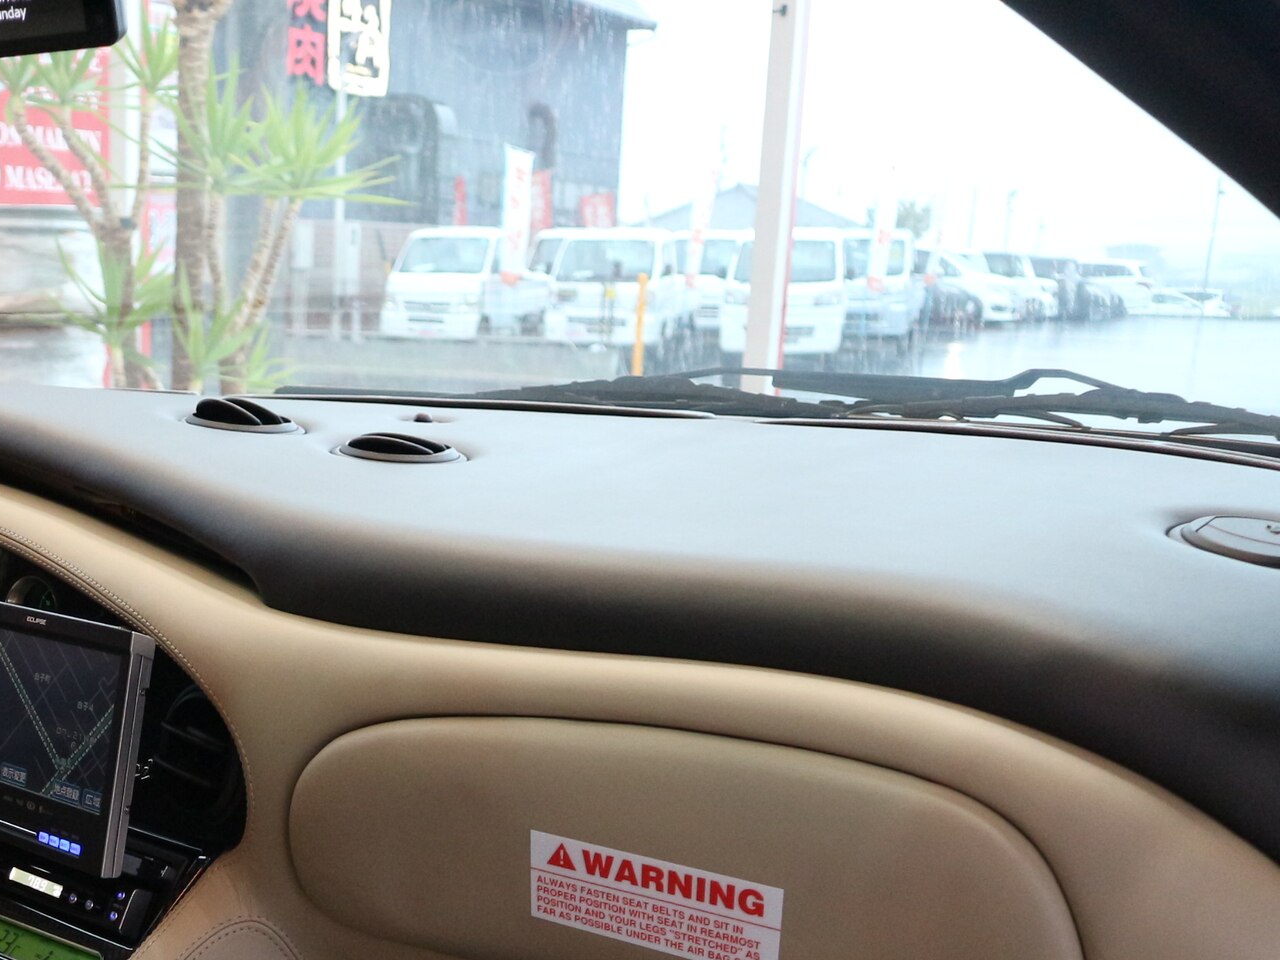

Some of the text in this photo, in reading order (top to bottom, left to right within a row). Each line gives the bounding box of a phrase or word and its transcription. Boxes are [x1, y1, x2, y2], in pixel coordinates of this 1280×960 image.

[26, 615, 47, 626] ECLIPSE
[537, 875, 743, 935] ALWAYS FASTEN SEAT BELTS AND SIT IN
[582, 849, 764, 917] WARNING
[537, 885, 761, 950] PROPER POSITION WITH SEAT IN REARMOST
[537, 895, 760, 960] POSITION AND YOUR LEGS "STRETCHED" AS
[537, 905, 556, 917] FAR
[559, 911, 572, 921] AS
[574, 915, 622, 935] POSSIBLE
[626, 928, 660, 945] UNDER
[664, 938, 684, 951] THE
[687, 945, 705, 957] AIR
